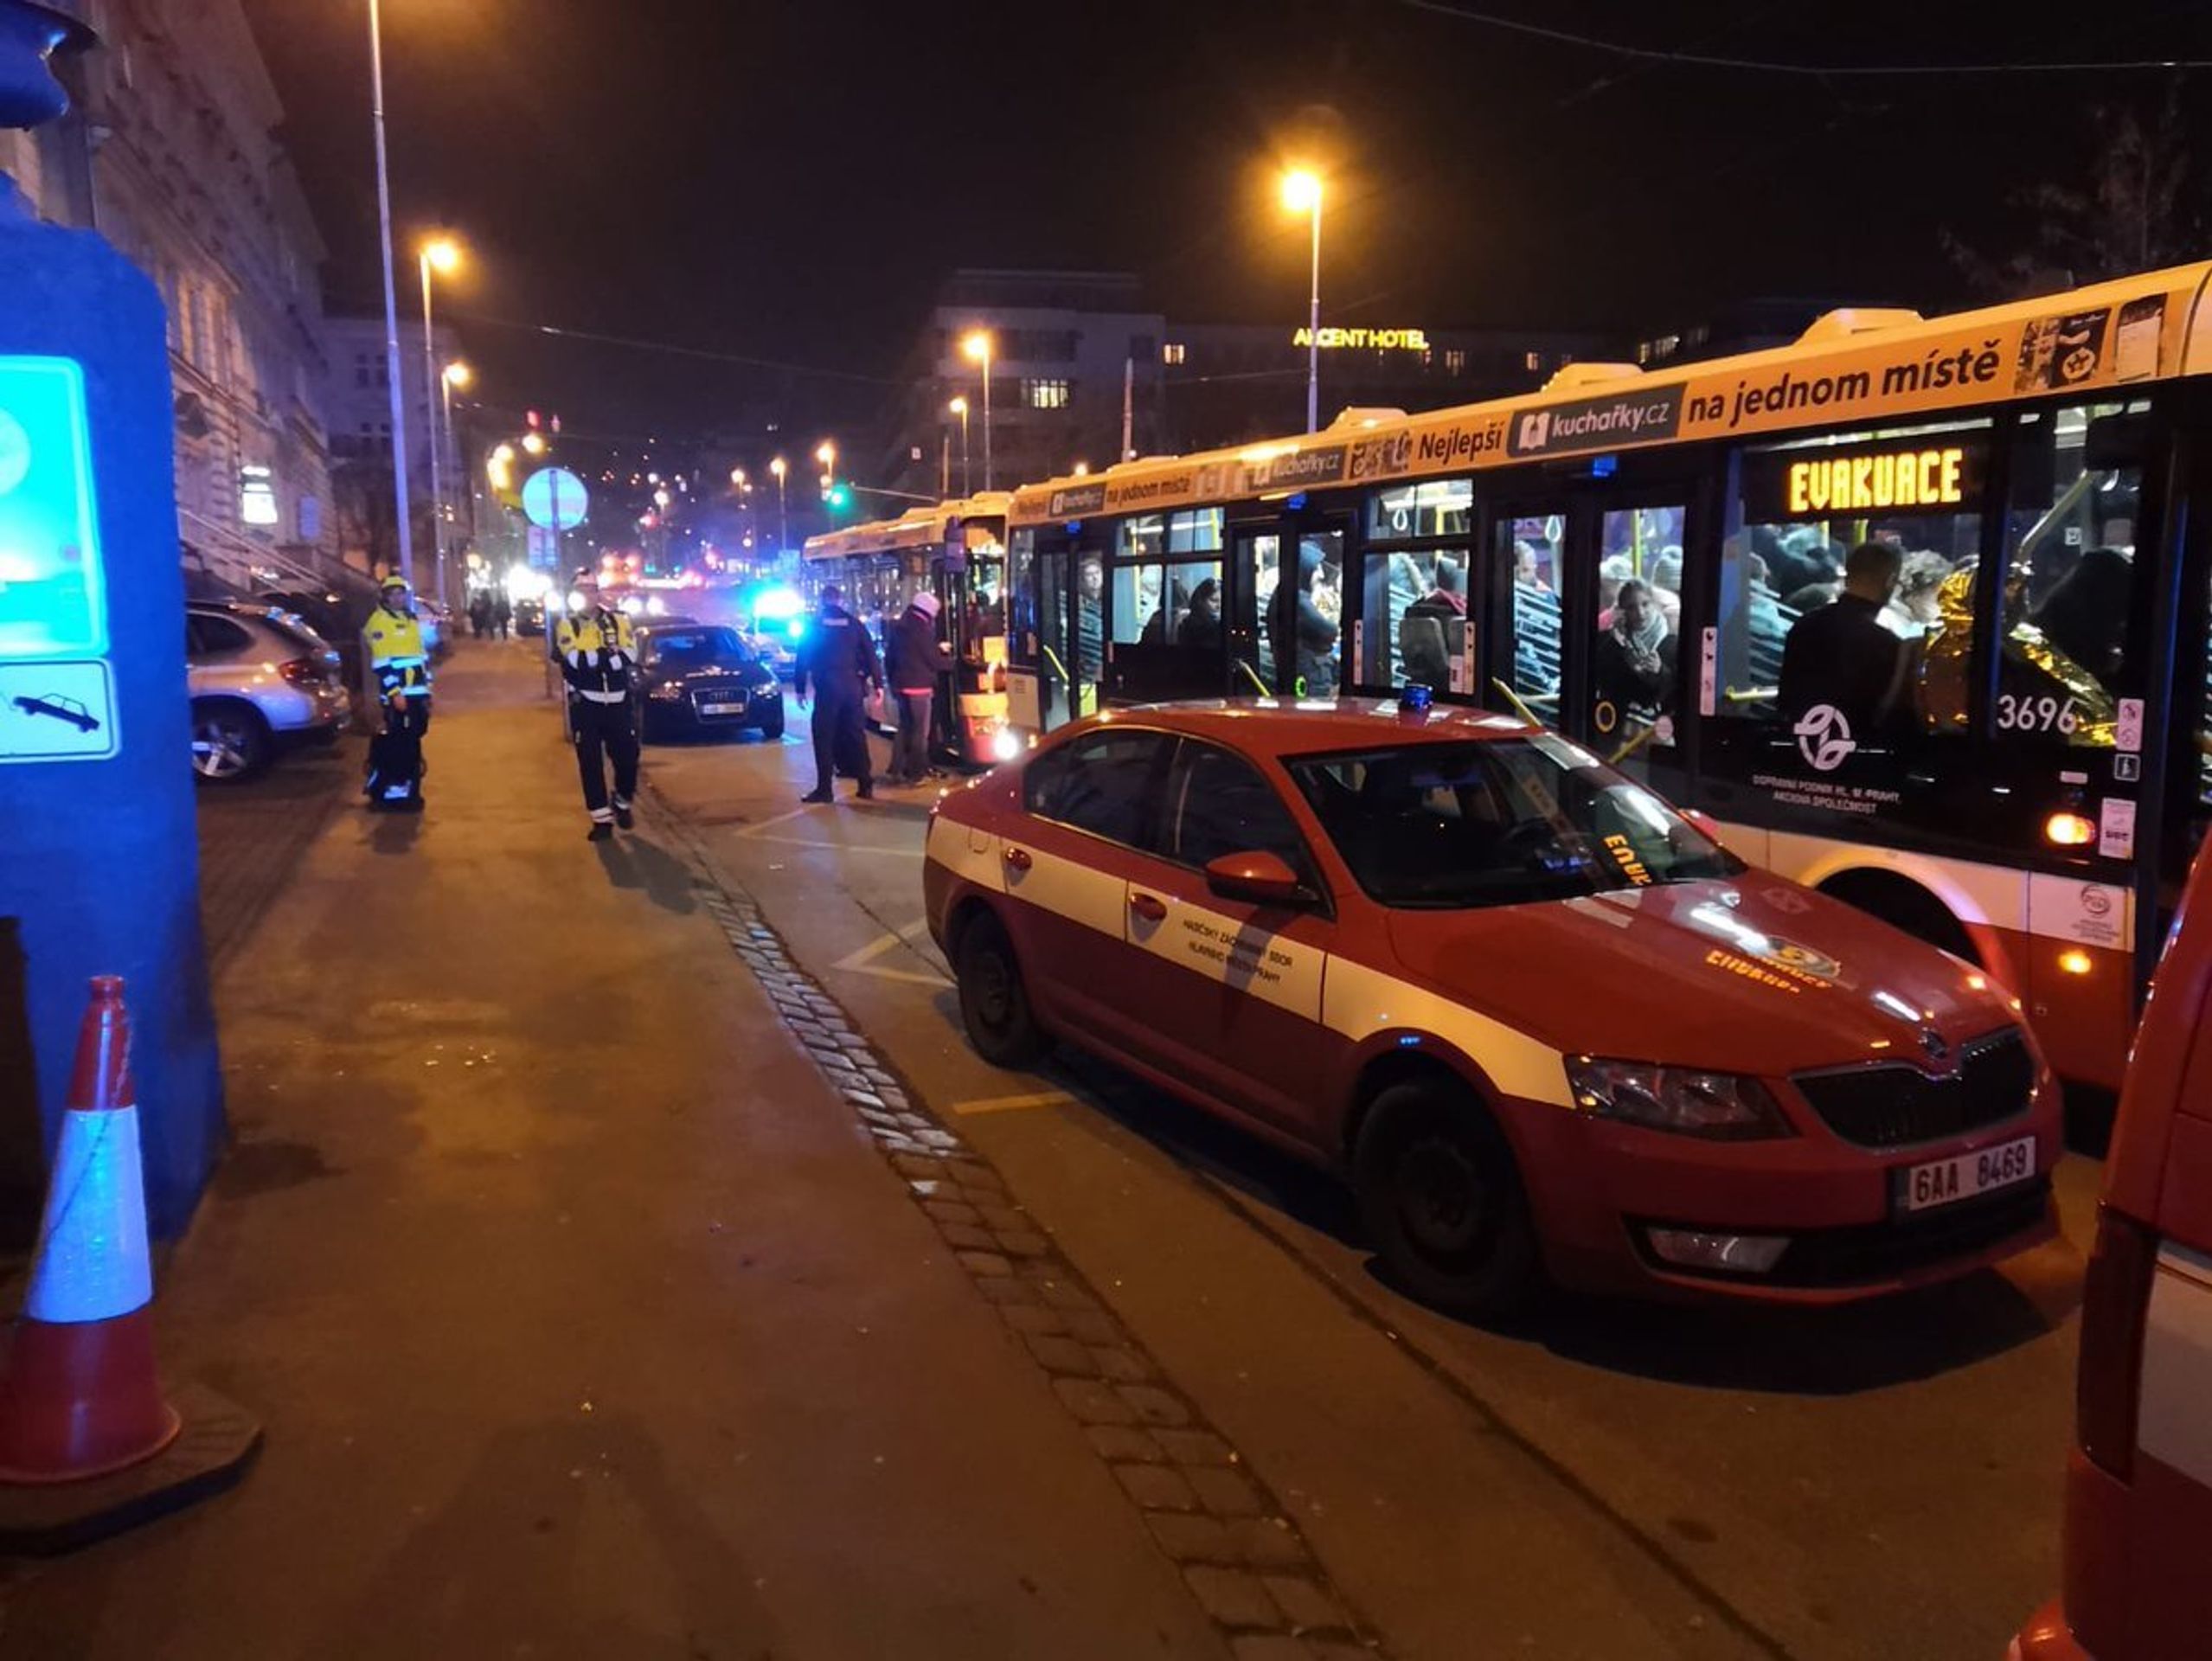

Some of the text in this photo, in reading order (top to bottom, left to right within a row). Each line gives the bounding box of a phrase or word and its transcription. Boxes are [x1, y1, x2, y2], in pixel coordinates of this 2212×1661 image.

[1369, 329, 1429, 350] HOTEL
[1418, 339, 2001, 465] Nejlepší kuchařky.cz na jednom místě
[1789, 447, 1963, 514] EVAKUACE
[1997, 694, 2076, 734] 3696
[1915, 1143, 2027, 1203] 6AA 8469
